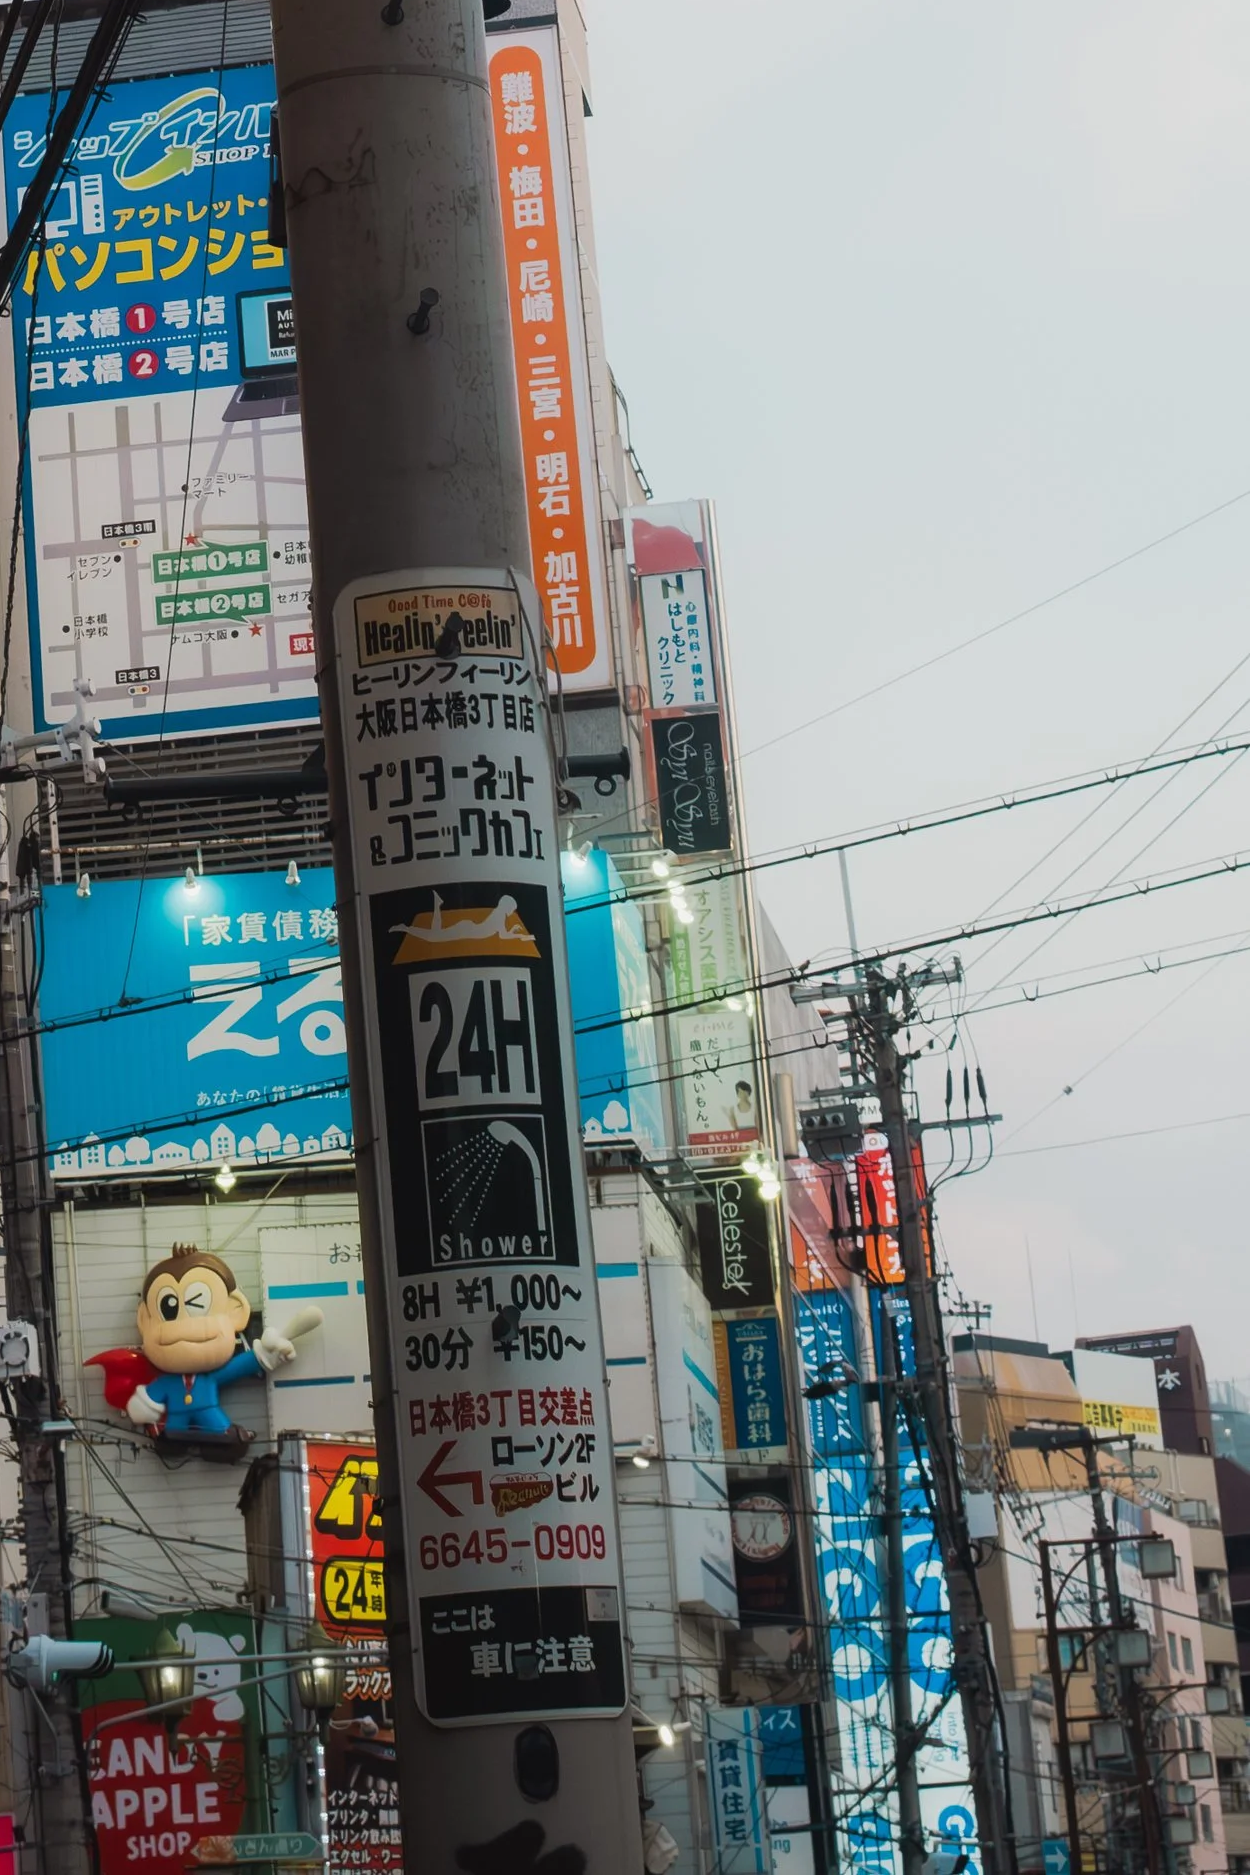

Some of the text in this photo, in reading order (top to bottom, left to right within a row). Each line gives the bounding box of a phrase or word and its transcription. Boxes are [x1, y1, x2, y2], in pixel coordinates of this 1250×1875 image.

[194, 146, 257, 166] SHOP
[192, 471, 250, 487] ファミリー
[192, 487, 227, 499] マート
[67, 566, 112, 581] イレブン
[78, 554, 111, 567] セブン
[422, 593, 454, 609] Time
[456, 611, 516, 654] eelin'
[668, 602, 686, 663] はしもと
[657, 636, 676, 705] クリニック
[355, 690, 535, 742] 大阪日本橋3丁目店
[419, 979, 536, 1099] 24H
[440, 1232, 549, 1261] Shower
[403, 1281, 441, 1322] 8H
[405, 1326, 475, 1372] 30分
[408, 1386, 596, 1438] 日本橋3丁目交差点
[742, 1343, 773, 1443] おはら歯科
[491, 1432, 597, 1467] ローソン2F
[556, 1472, 601, 1503] ビル
[419, 1524, 606, 1571] 6645-0909
[432, 1604, 497, 1634] ここは
[470, 1635, 597, 1677] 車に注意
[92, 1782, 222, 1830] APPLE
[717, 1738, 747, 1842] 賃貸住宅
[127, 1831, 192, 1861] SHOP
